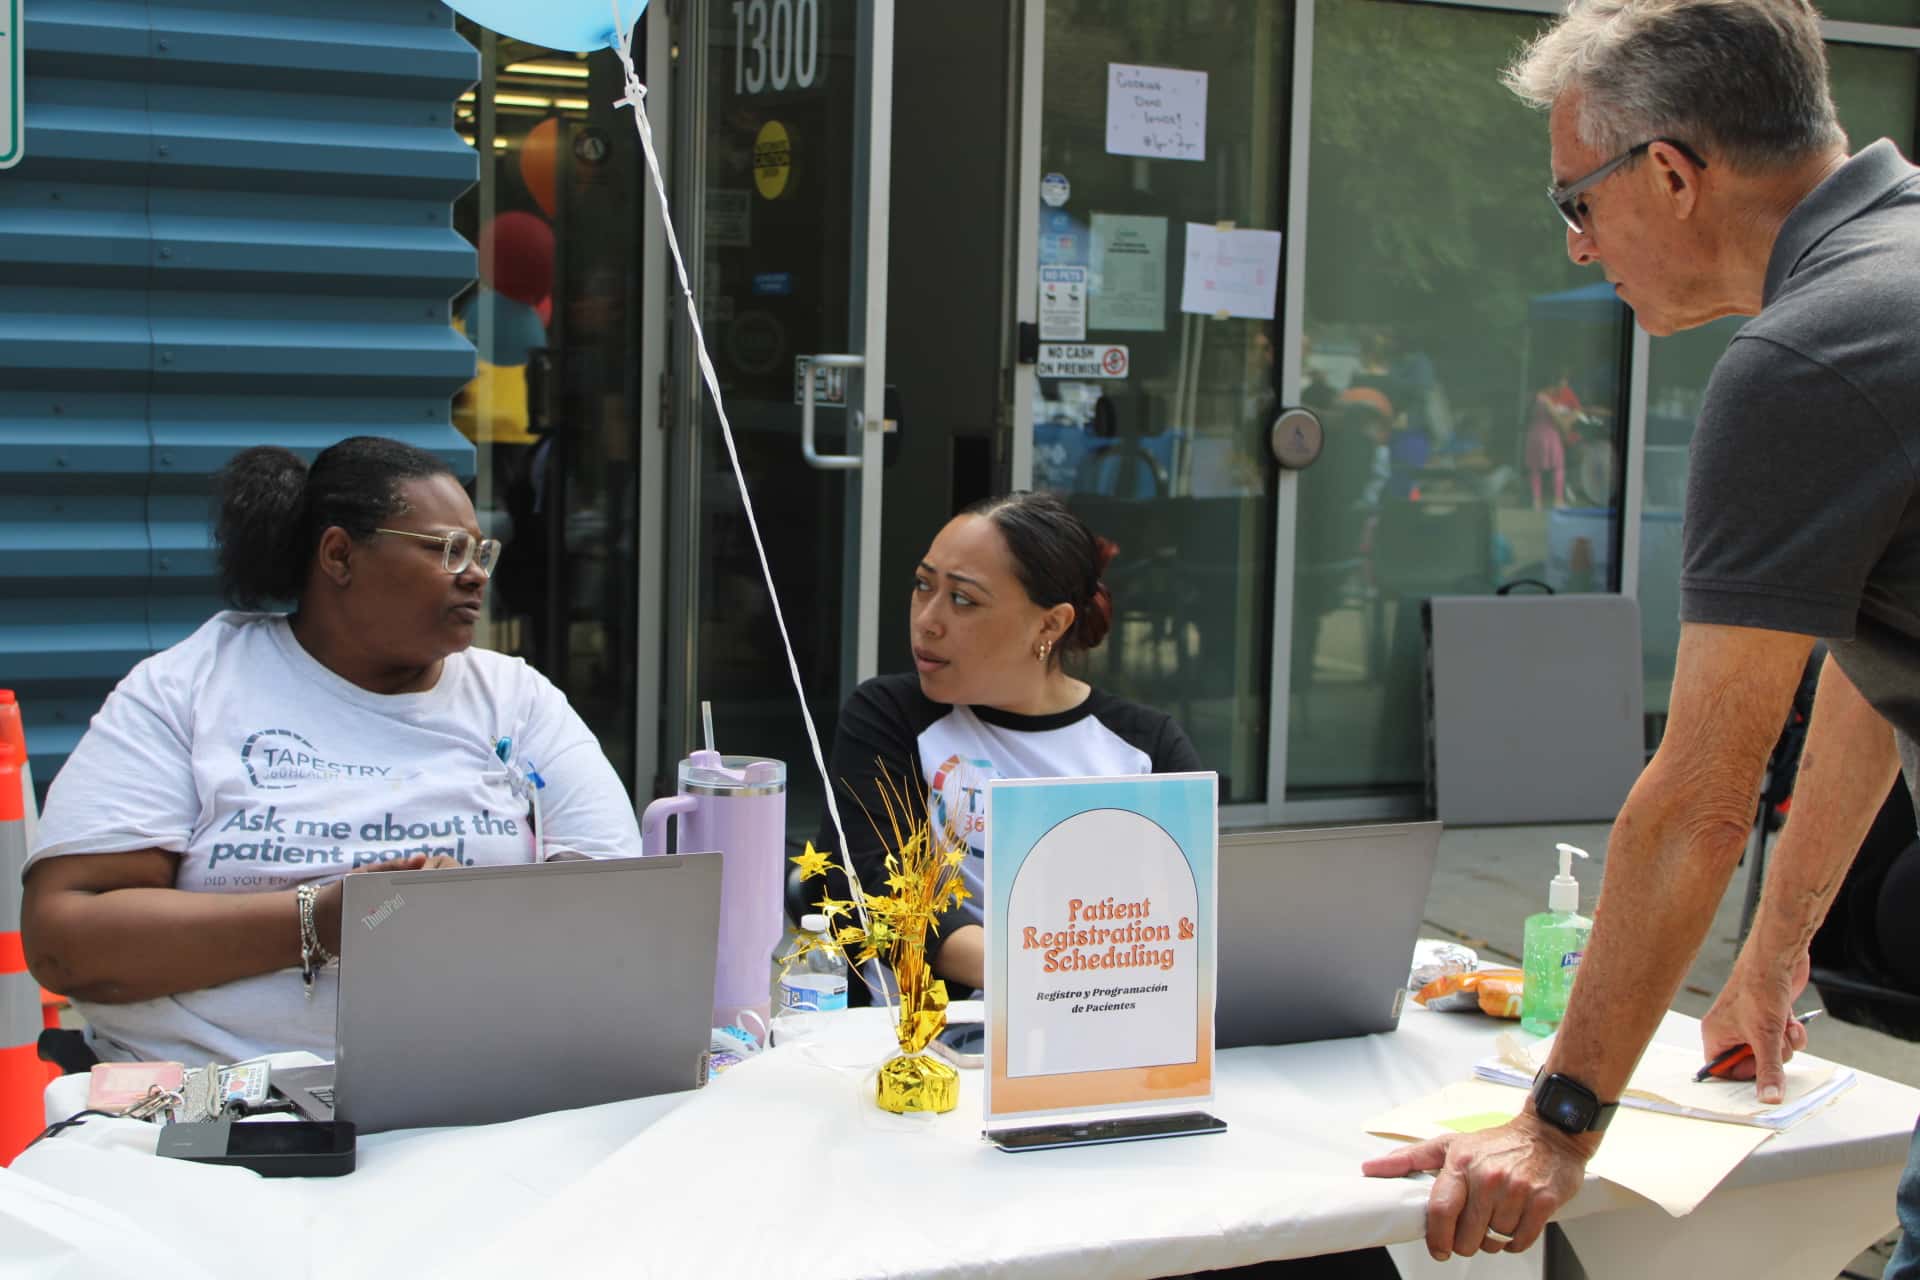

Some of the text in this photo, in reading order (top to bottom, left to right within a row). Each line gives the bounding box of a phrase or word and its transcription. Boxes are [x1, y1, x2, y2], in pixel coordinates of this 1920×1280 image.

[733, 0, 818, 95] 1300
[1048, 346, 1095, 359] NO CASH
[1038, 362, 1102, 375] ON PREMISE
[263, 748, 393, 777] TAPESTRY
[220, 806, 518, 842] Ask me about the
[208, 836, 347, 869] patient
[203, 875, 290, 887] DID YOU EN
[360, 890, 407, 931] ThinkPad
[1067, 897, 1151, 922] Patient
[1022, 916, 1195, 951] Registration &
[1042, 944, 1176, 974] Scheduling
[1036, 982, 1168, 1001] Registro y Programación
[1071, 1000, 1136, 1014] de Pacientes
